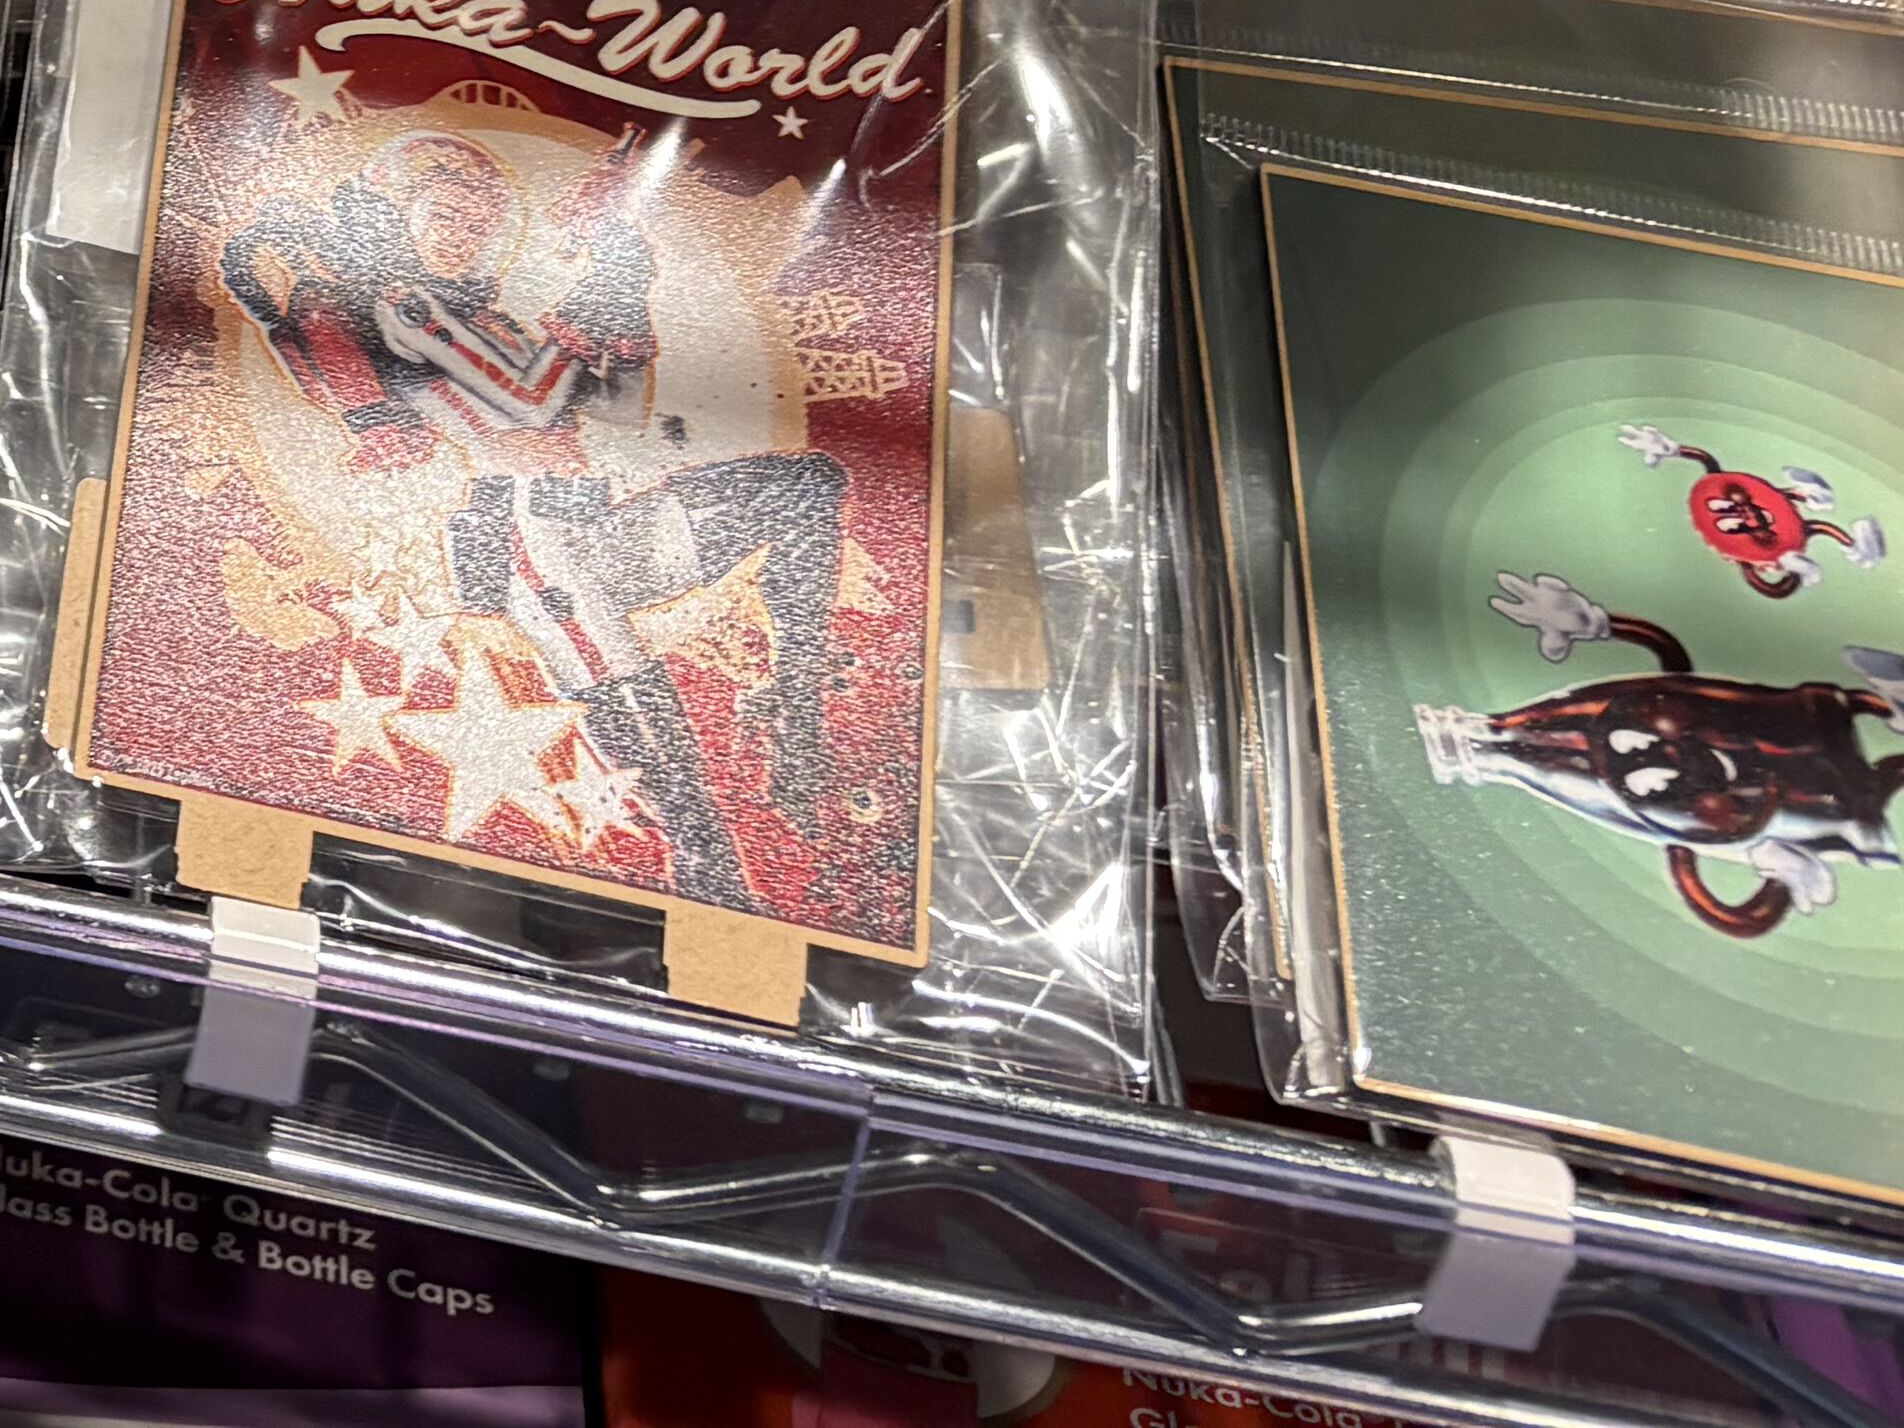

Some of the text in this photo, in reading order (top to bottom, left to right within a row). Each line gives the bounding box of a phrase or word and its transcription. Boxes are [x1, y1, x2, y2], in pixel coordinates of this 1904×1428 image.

[83, 1202, 200, 1254] Bottle
[214, 1230, 247, 1265] &
[257, 1240, 376, 1292] Bottle
[385, 1267, 495, 1317] Caps
[222, 1194, 376, 1252] Quartz
